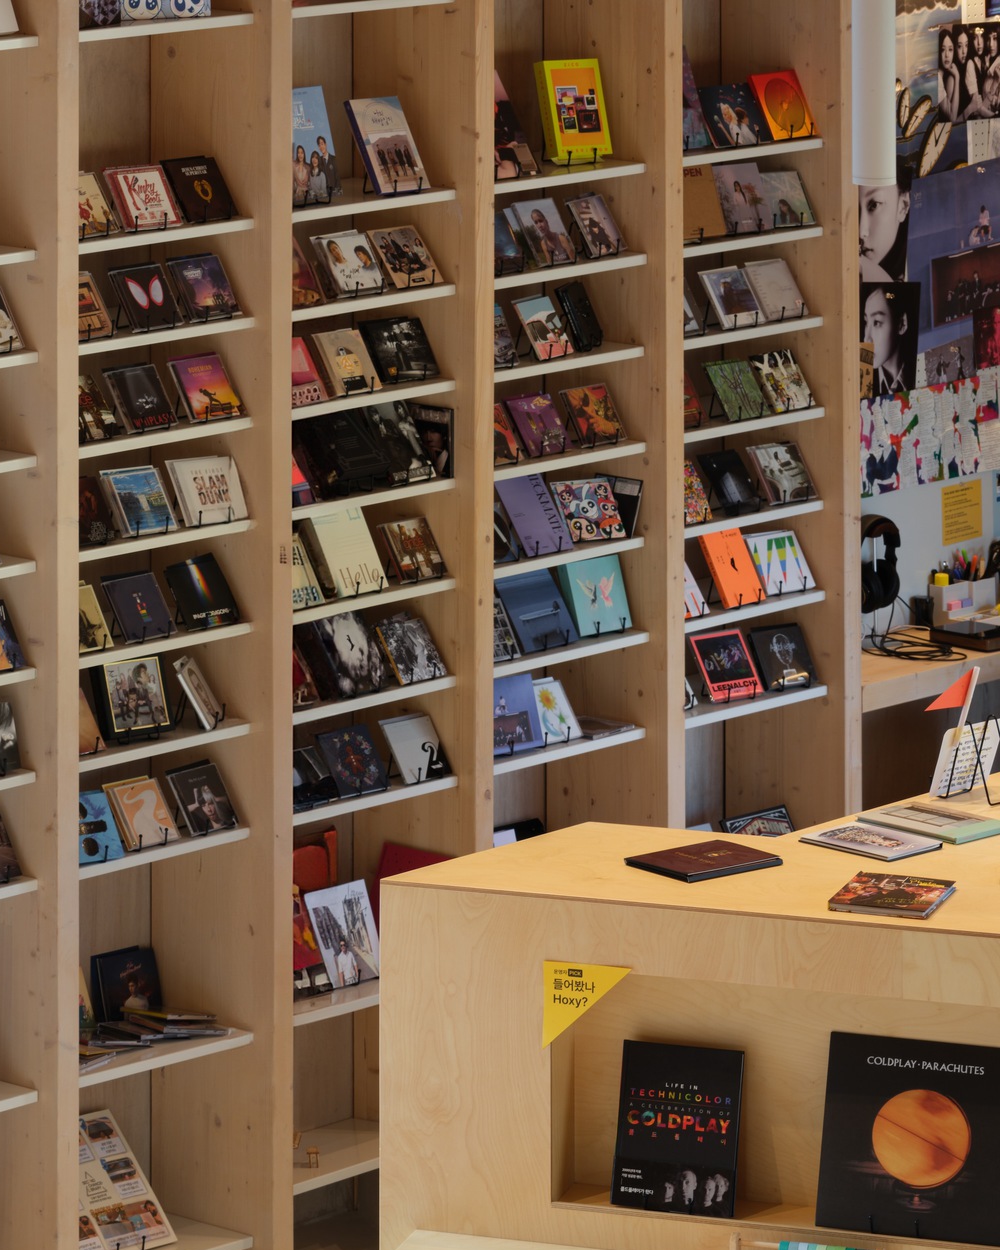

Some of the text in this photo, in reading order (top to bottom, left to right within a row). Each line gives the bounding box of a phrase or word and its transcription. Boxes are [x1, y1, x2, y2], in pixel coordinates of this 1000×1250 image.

[193, 474, 229, 491] SLAM
[198, 488, 232, 506] DUNK
[339, 563, 380, 588] Hello
[569, 969, 582, 977] PICK
[553, 978, 596, 994] 들어봤나
[553, 994, 588, 1009] Hoxy?
[867, 1055, 985, 1076] COLDPLAY PARACHUTES
[630, 1088, 732, 1105] TECHNICOLOR
[641, 1103, 711, 1115] CELEBRATION
[627, 1109, 731, 1134] COLDPLAY
